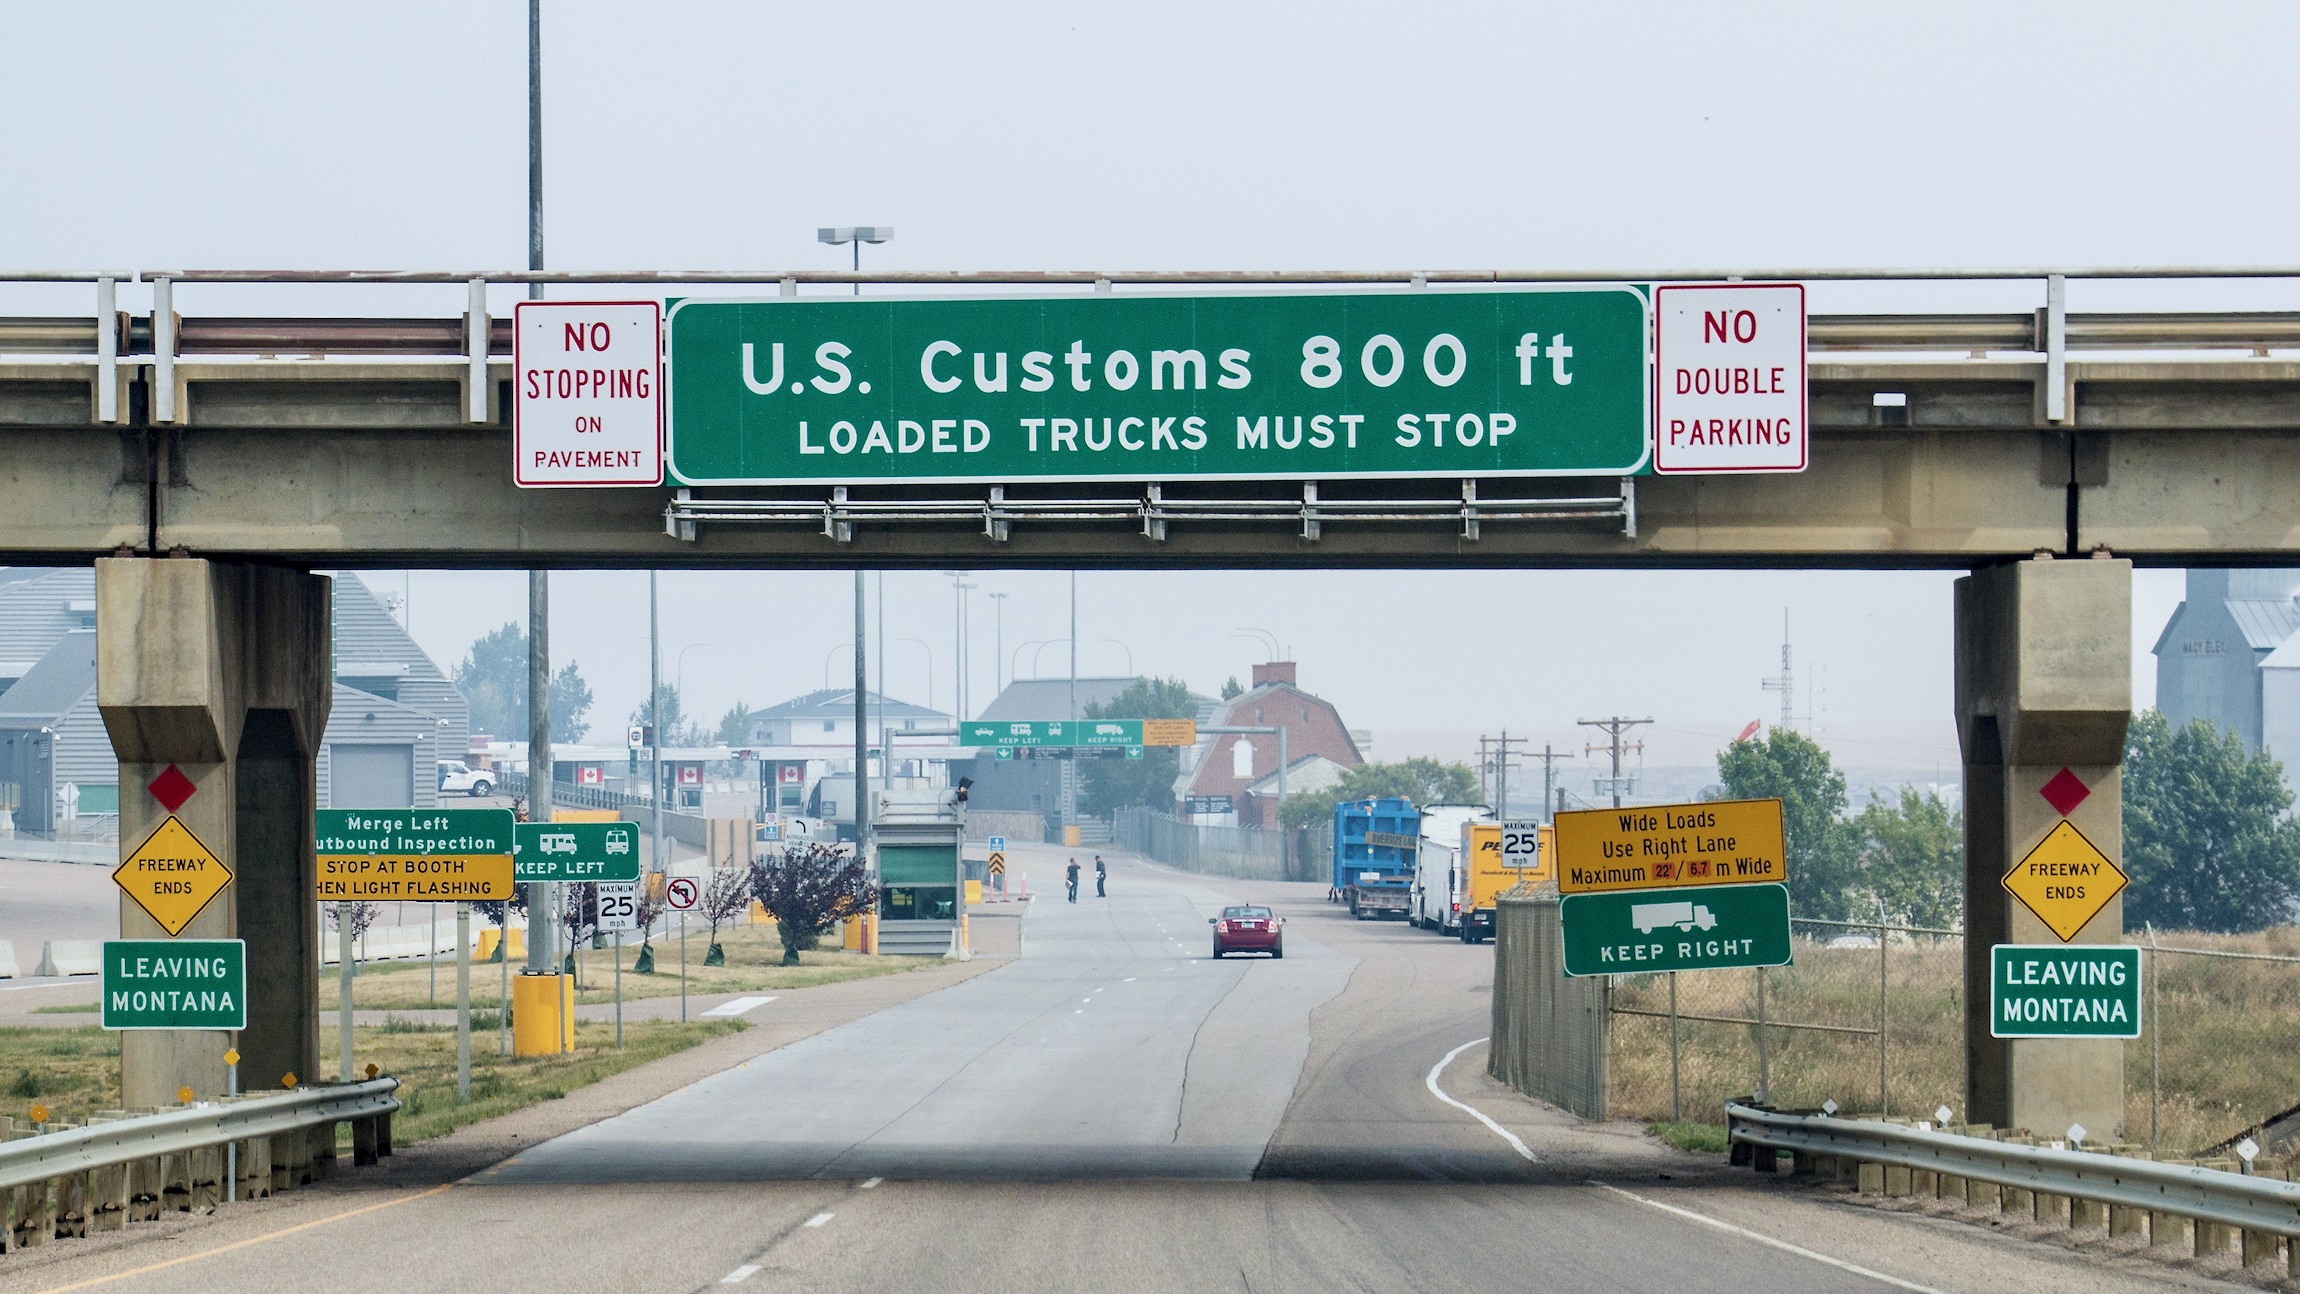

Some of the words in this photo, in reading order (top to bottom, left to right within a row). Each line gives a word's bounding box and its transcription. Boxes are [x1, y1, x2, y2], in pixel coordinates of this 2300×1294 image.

[1705, 310, 1756, 343] NO
[566, 323, 610, 351] NO
[743, 342, 871, 395] U.S.
[921, 340, 1251, 393] Customs
[1301, 333, 1466, 388] 800
[1516, 333, 1572, 385] ft
[528, 369, 648, 399] STOPPING
[1677, 368, 1784, 394] DOUBLE
[576, 417, 600, 432] ON
[800, 420, 990, 454] LOADED
[1021, 416, 1207, 451] TRUCKS
[1237, 415, 1364, 449] MUST
[1395, 413, 1516, 447] STOP
[1671, 419, 1790, 445] PARKING
[536, 451, 641, 467] PAVEMENT
[349, 817, 402, 833] Merge
[412, 817, 448, 830] Left
[1619, 815, 1657, 832] Wide
[1667, 811, 1715, 829] Loads
[316, 837, 388, 849] utbound
[398, 837, 496, 852] Inspection
[1481, 842, 1544, 851] PEE
[1505, 834, 1535, 853] 25
[1603, 841, 1633, 858] Use
[1643, 837, 1687, 860] Right
[1697, 836, 1735, 852] Lane
[139, 859, 206, 871] FREEWAY
[327, 861, 369, 873] STOP
[377, 861, 397, 873] AT
[406, 861, 463, 873] BOOTH
[516, 863, 557, 874] KEEP
[566, 862, 604, 873] LEFT
[1512, 857, 1528, 865] mph
[2031, 864, 2100, 876] FREEWAY
[1572, 868, 1645, 884] Maximum
[1691, 862, 1707, 875] 6.7
[1717, 863, 1729, 876] m
[1736, 858, 1771, 875] Wide
[155, 882, 191, 894] ENDS
[315, 882, 345, 894] HEN
[354, 882, 400, 893] LIGHT
[408, 882, 490, 894] FLASHING
[2047, 887, 2084, 898] ENDS
[602, 897, 633, 916] 25
[1601, 944, 1663, 961] KEEP
[1678, 939, 1752, 958] RIGHT
[121, 958, 225, 978] LEAVING
[2007, 961, 2125, 985] LEAVING
[113, 991, 234, 1011] MONTANA
[2004, 998, 2127, 1022] MONTANA
